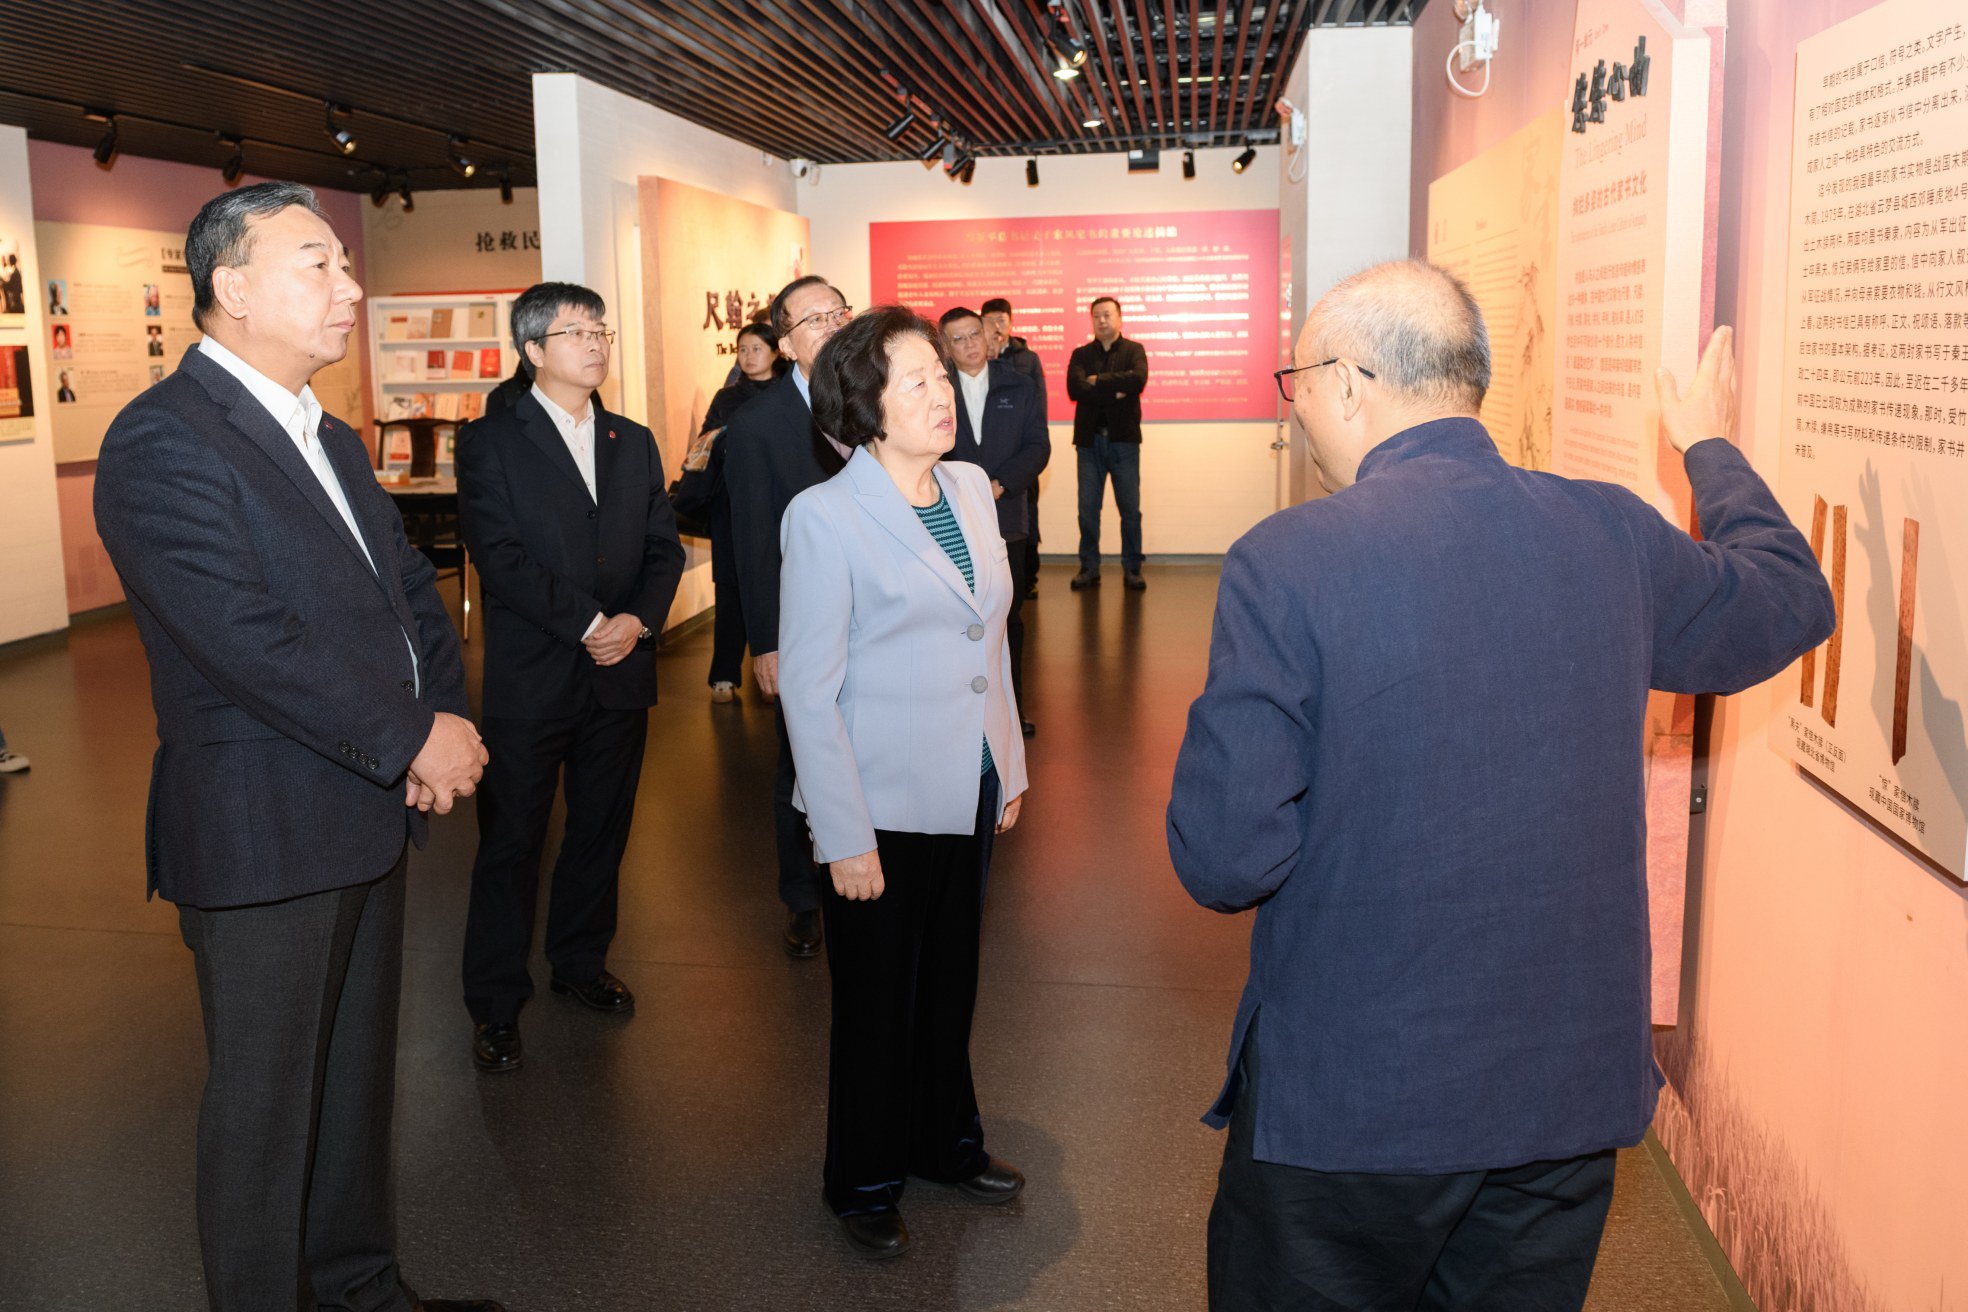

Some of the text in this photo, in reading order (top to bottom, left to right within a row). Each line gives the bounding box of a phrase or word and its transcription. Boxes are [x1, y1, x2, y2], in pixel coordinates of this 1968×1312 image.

[1809, 53, 1968, 122] 有了相对固定的载体和格式。先秦典籍中有不少
[1625, 113, 1647, 143] Mind
[1802, 248, 1968, 278] 士卒黑夫、惊兄弟俩写给家里的信，信中向家人叙
[703, 289, 777, 331] 尺翰之
